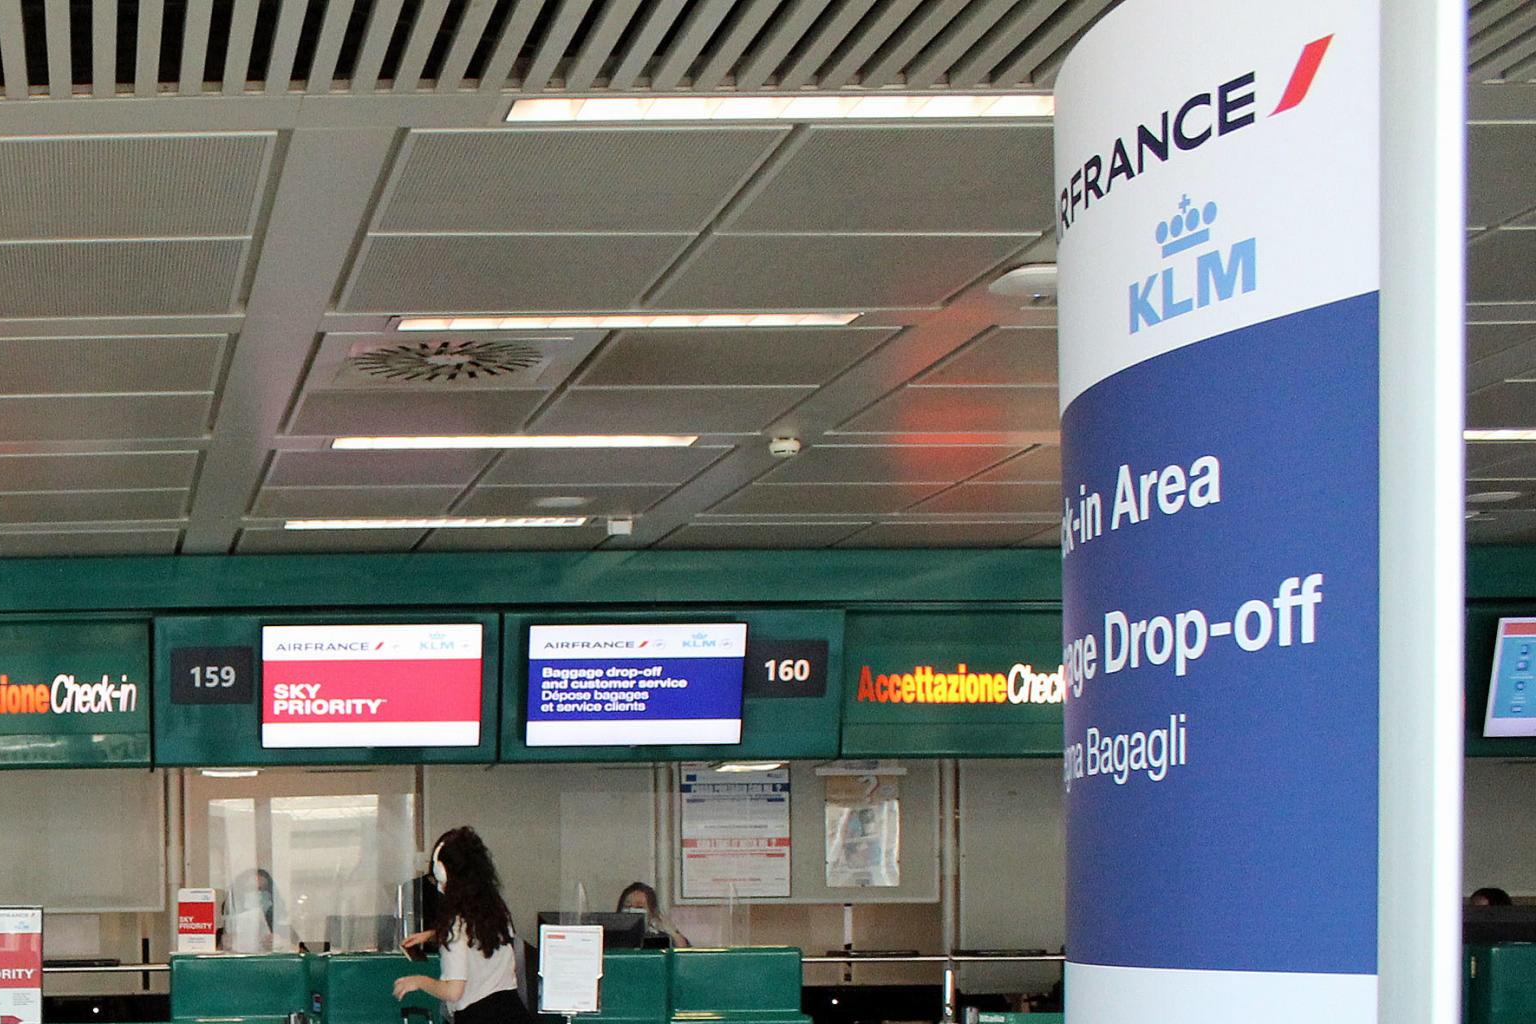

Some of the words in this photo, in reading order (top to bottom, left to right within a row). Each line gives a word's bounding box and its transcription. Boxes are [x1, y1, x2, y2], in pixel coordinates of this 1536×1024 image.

[1129, 238, 1256, 334] KLM
[1111, 455, 1220, 530] Area
[1104, 573, 1323, 676] Drop-off
[276, 642, 369, 652] AIRFRANCE
[419, 641, 455, 650] KLM
[544, 641, 634, 649] AIRFRANCE
[682, 639, 716, 648] KLM
[190, 666, 236, 688] 159
[542, 667, 604, 679] Baggage
[606, 666, 663, 678] drop-off
[765, 659, 811, 682] 160
[273, 683, 321, 699] SKY
[541, 679, 568, 689] and
[570, 679, 636, 689] customer
[638, 678, 688, 688] service
[857, 663, 1007, 703] Accettazione
[50, 673, 137, 713] Check-in
[541, 690, 591, 702] Dépose
[594, 690, 649, 702] bagages
[541, 702, 554, 712] et
[556, 701, 602, 712] service
[604, 701, 646, 711] clients
[1087, 714, 1187, 784] Bagagli
